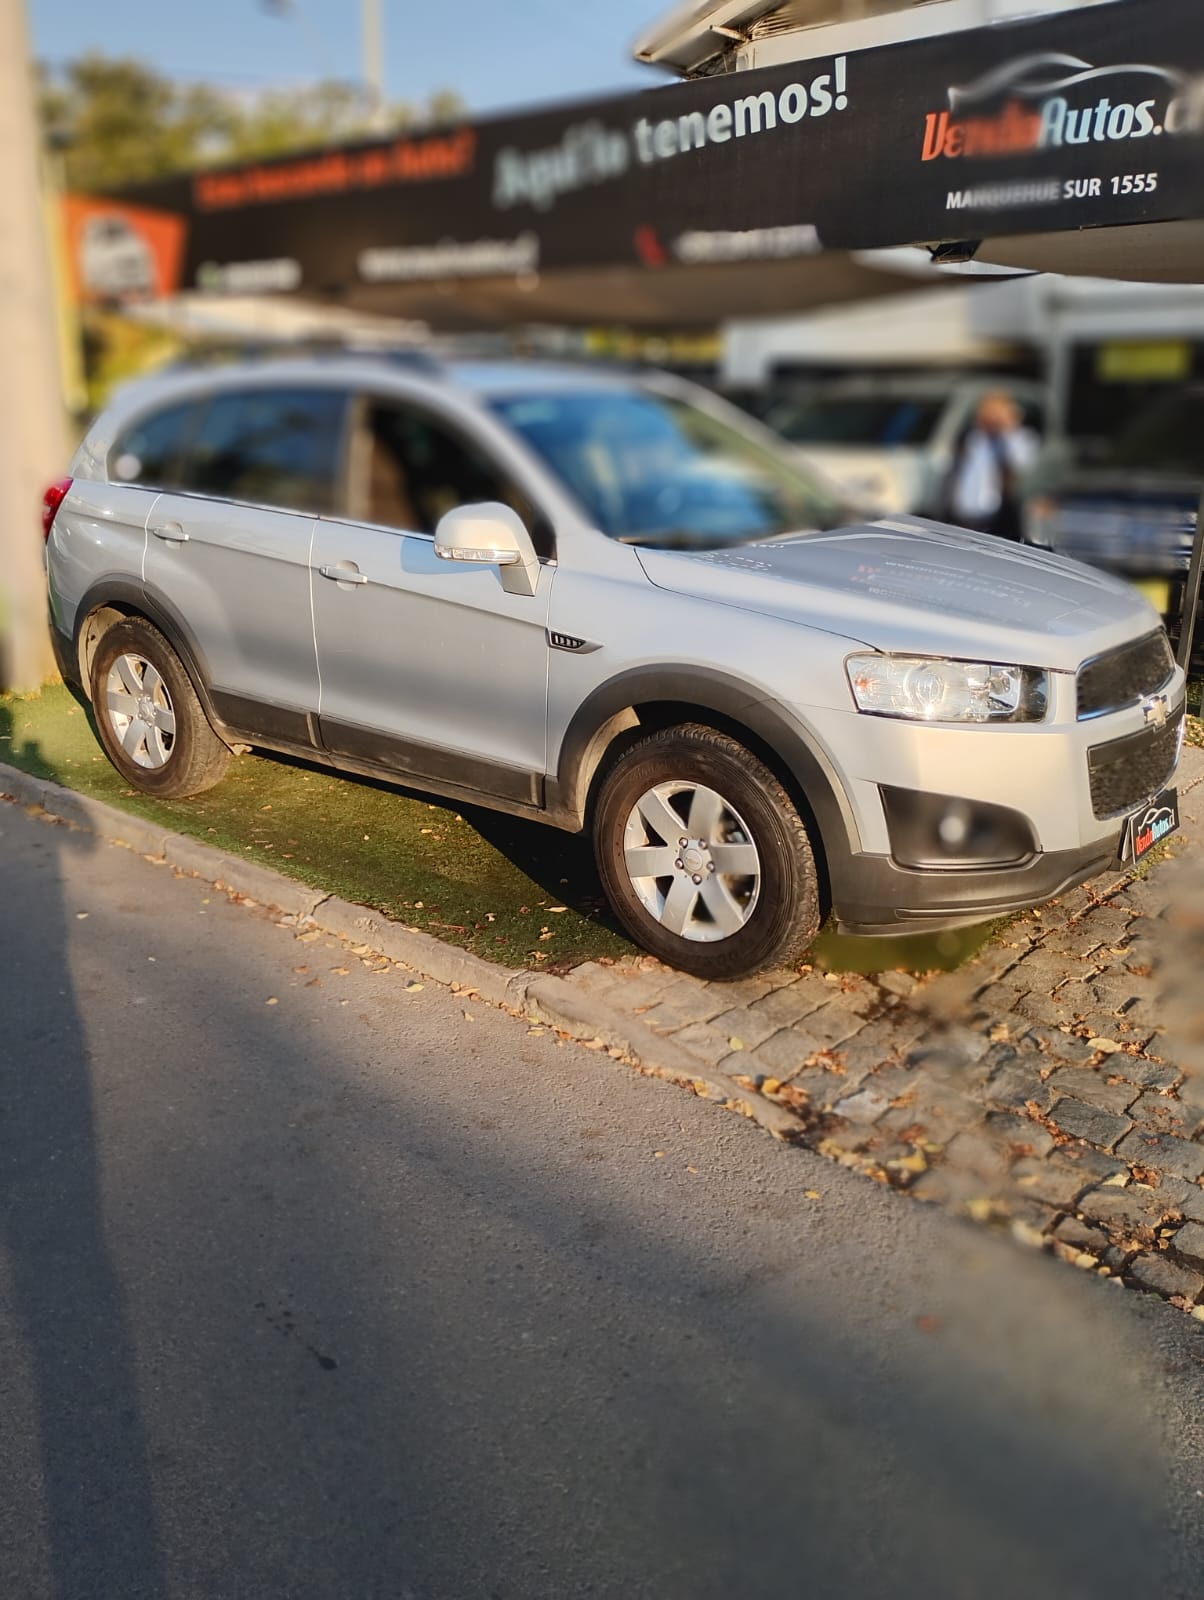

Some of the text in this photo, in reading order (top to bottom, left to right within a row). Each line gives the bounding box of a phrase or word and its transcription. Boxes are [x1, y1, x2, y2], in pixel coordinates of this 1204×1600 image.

[634, 55, 848, 163] tenemos!
[1063, 178, 1102, 199] SUR
[1111, 173, 1158, 195] 1555
